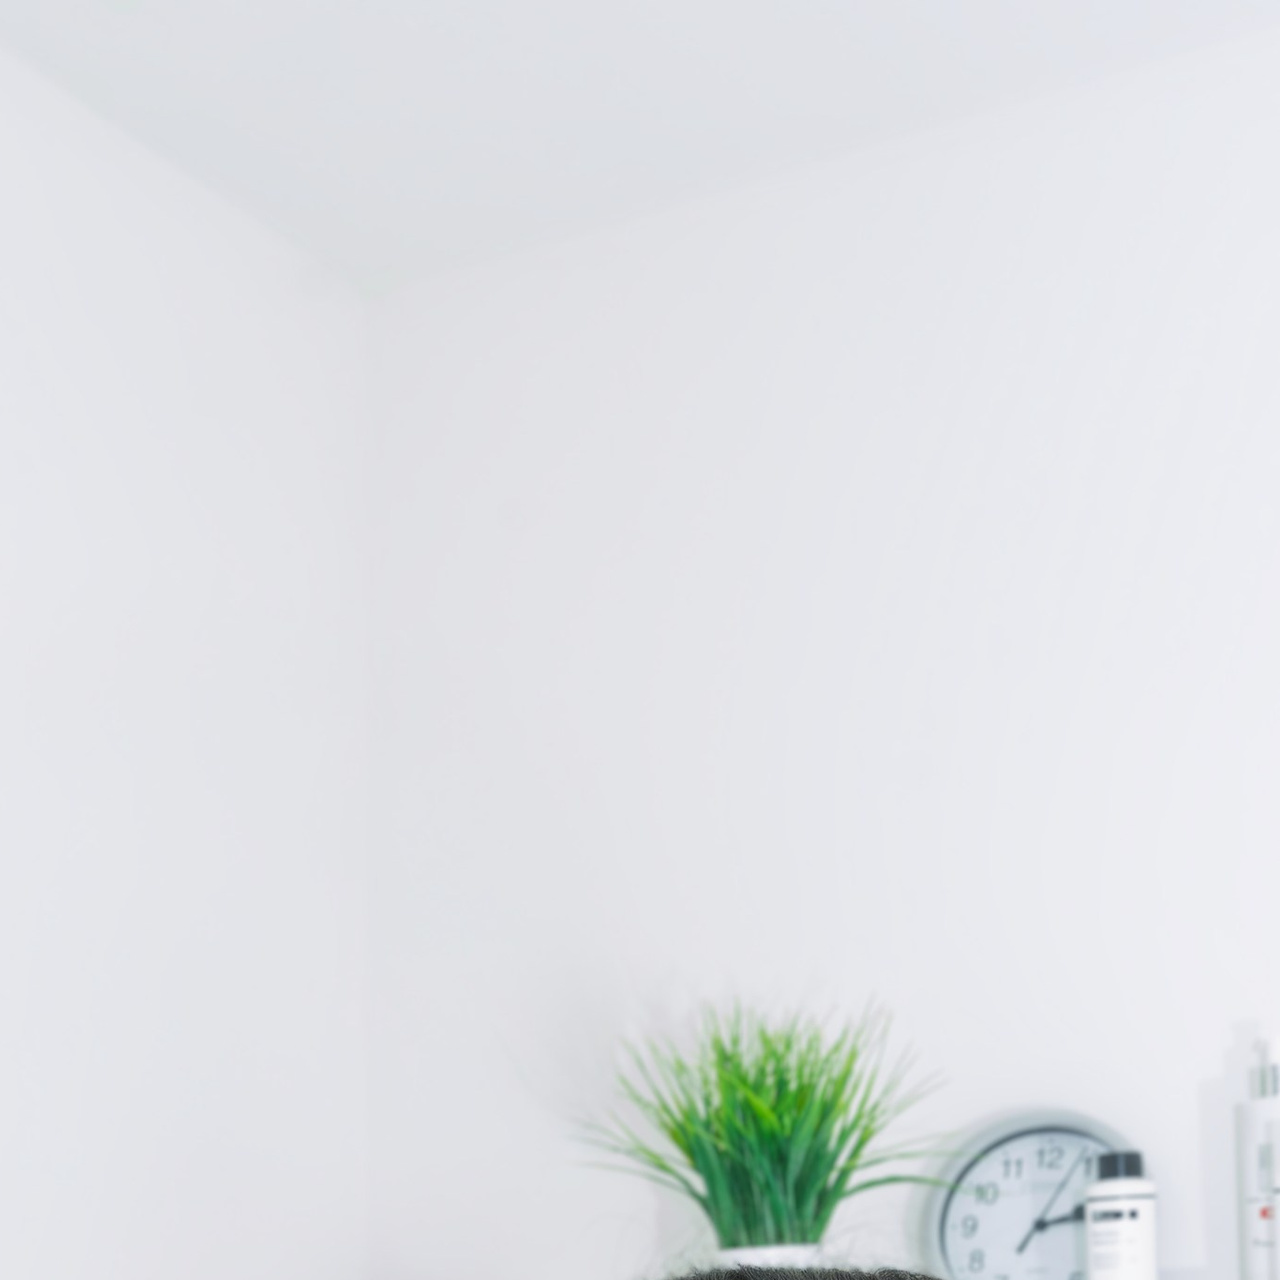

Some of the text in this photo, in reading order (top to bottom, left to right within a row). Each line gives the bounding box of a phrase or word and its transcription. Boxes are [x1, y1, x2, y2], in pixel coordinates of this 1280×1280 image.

[1003, 1158, 1023, 1179] 11
[1036, 1147, 1064, 1170] 12
[975, 1181, 1000, 1206] 10
[961, 1214, 979, 1239] 9
[968, 1249, 985, 1273] 8
